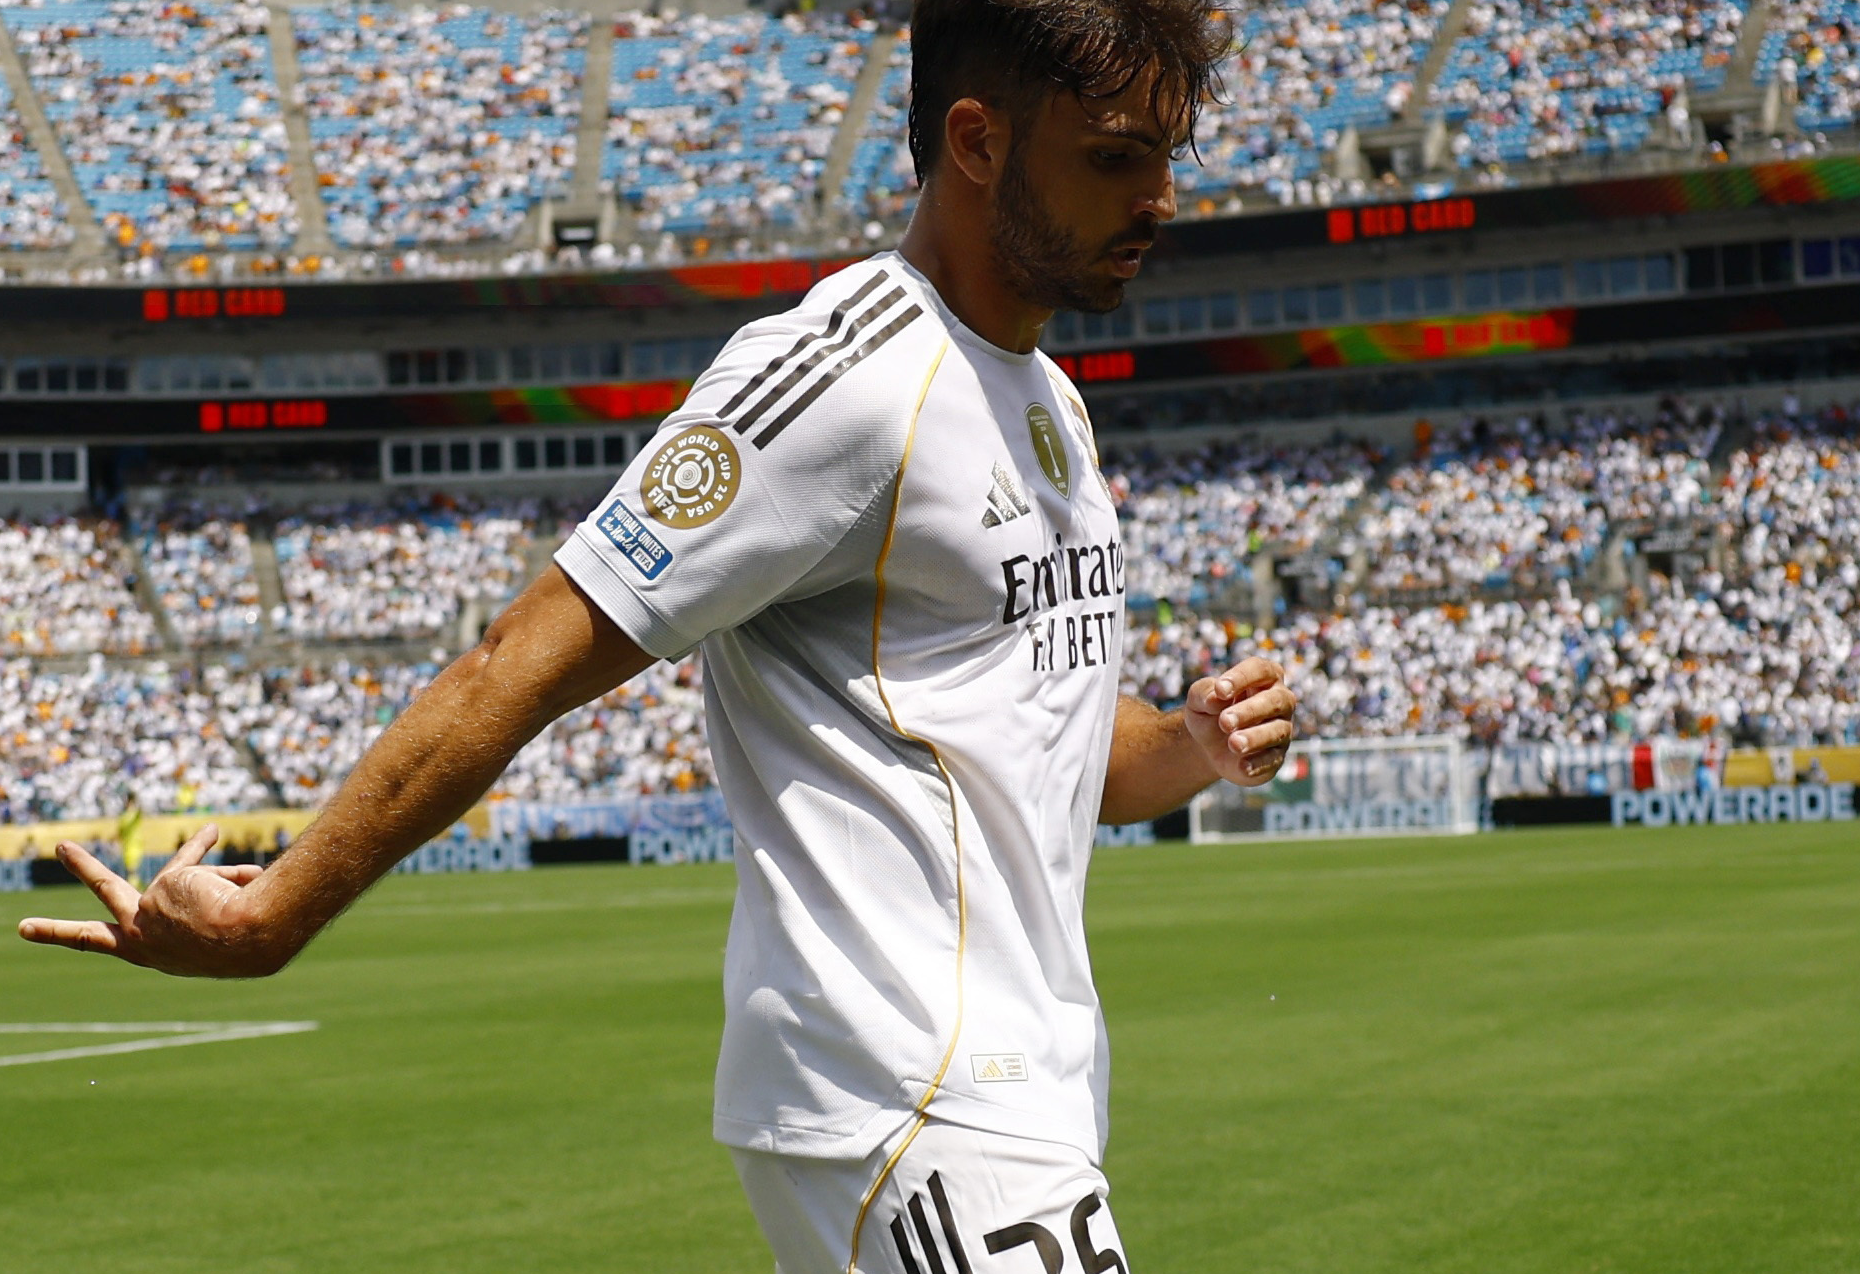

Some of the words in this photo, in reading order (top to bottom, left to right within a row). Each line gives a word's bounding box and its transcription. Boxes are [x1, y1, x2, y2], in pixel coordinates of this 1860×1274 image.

[677, 434, 719, 451] WORLD
[651, 447, 675, 478] CLUB
[717, 452, 731, 480] CUP
[647, 485, 676, 520] FIFA
[713, 484, 728, 502] 25
[685, 500, 715, 518] USA
[1612, 784, 1855, 827] POWERADE
